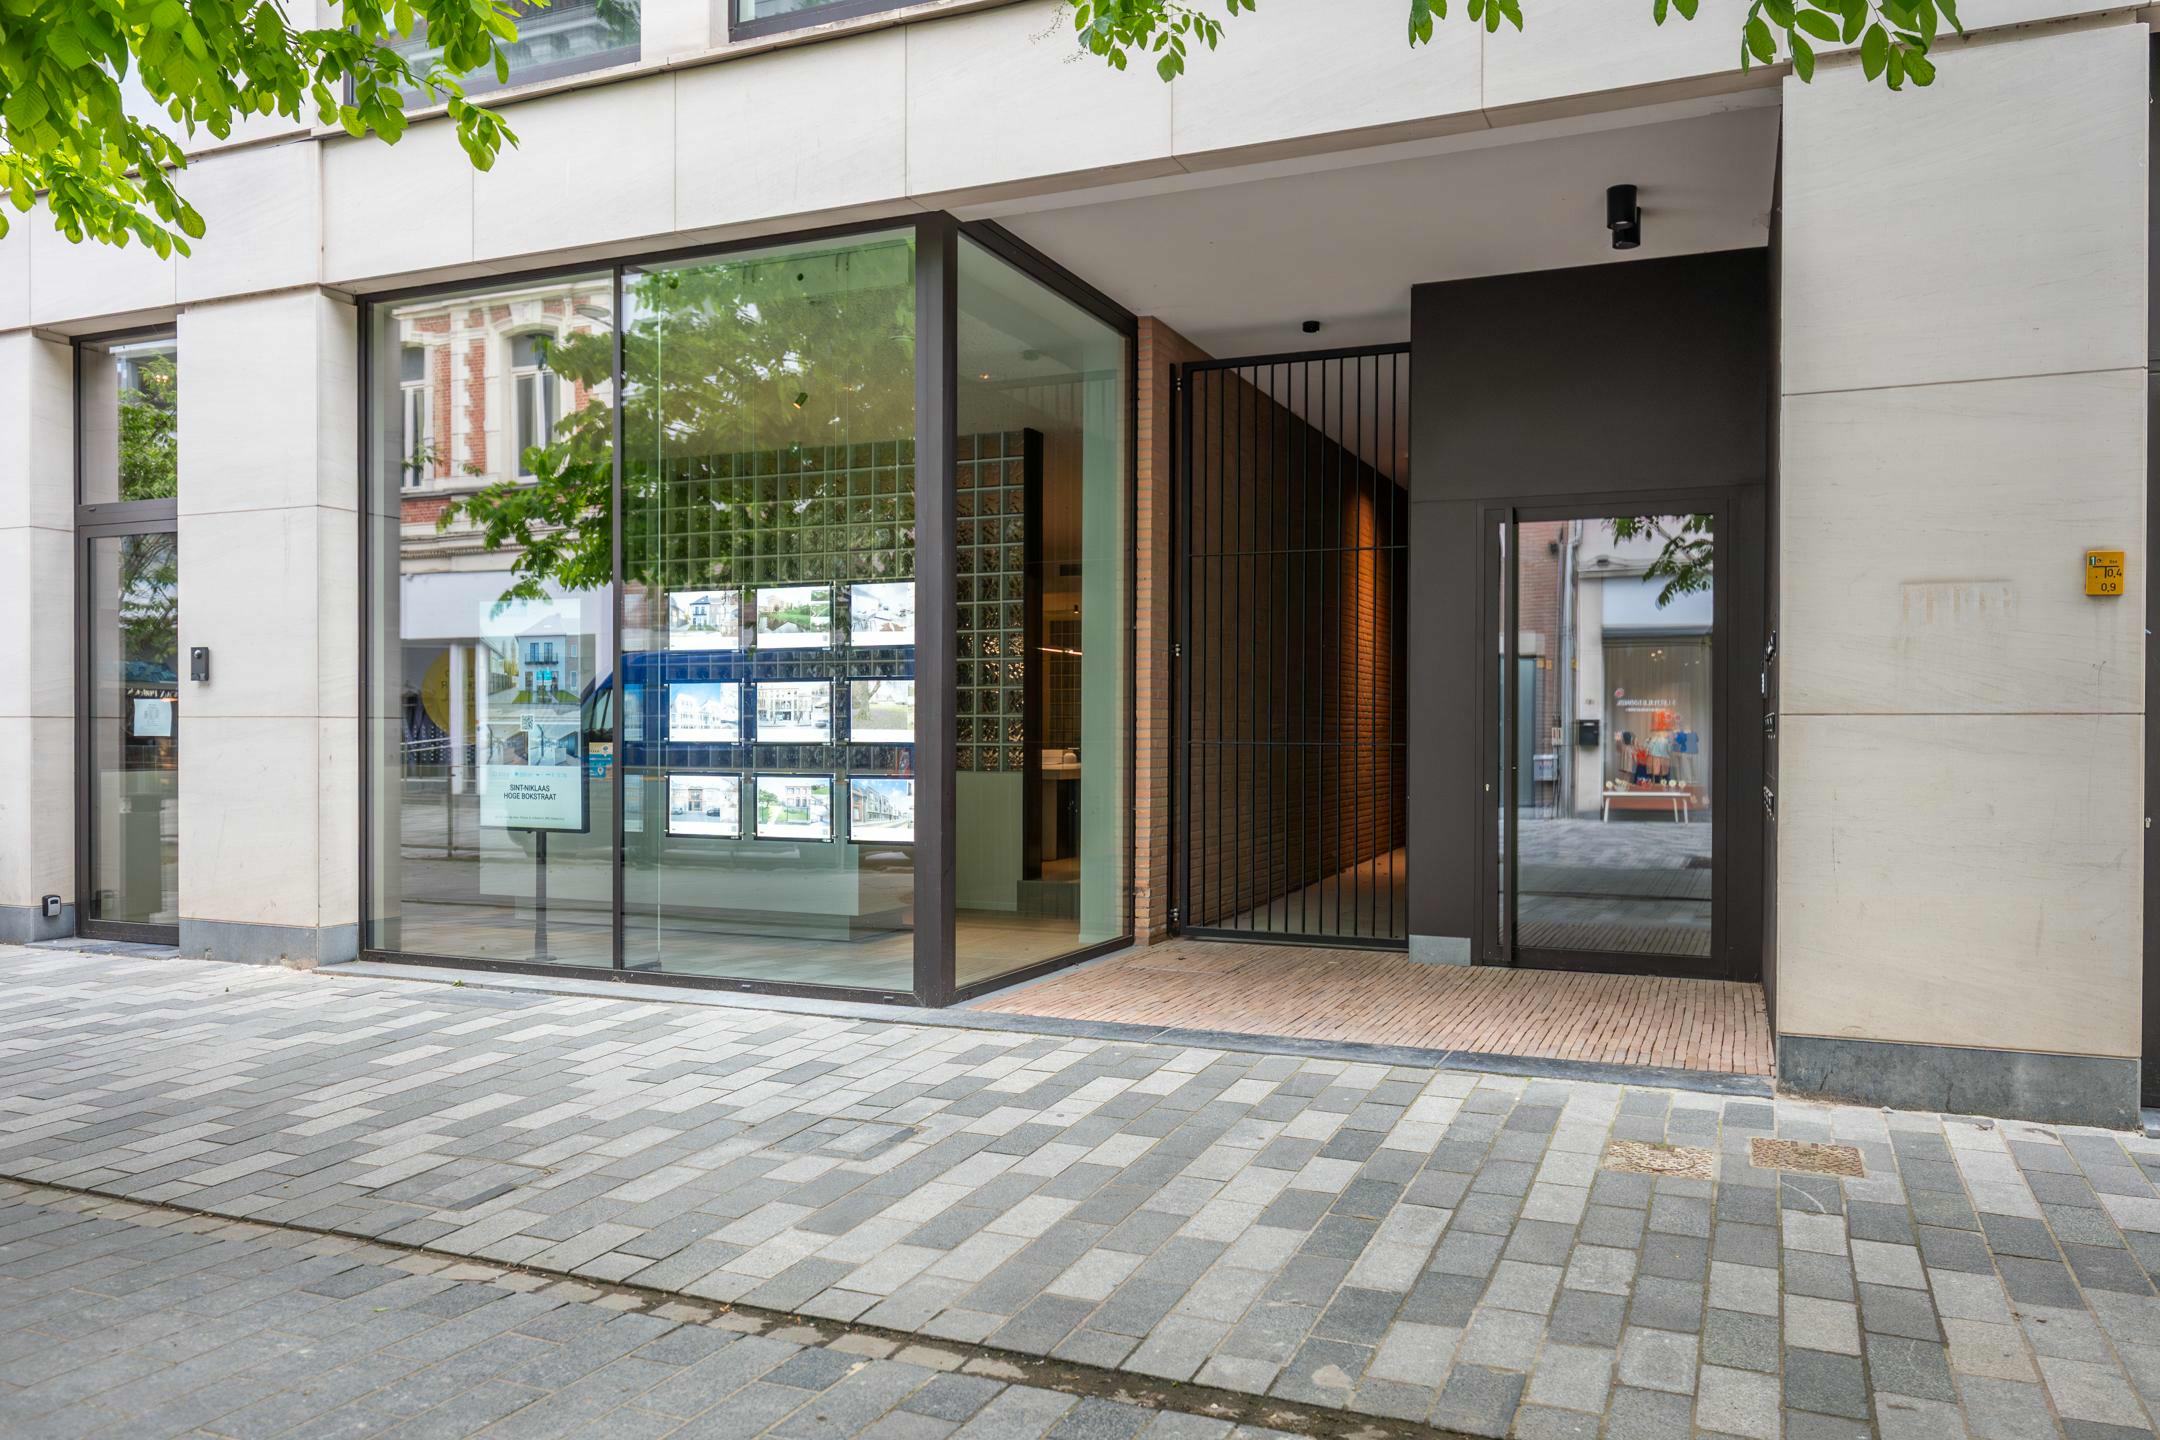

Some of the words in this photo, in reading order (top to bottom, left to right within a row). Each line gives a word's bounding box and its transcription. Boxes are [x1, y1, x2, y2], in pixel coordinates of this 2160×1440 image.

[509, 784, 550, 792] SINT-NIKLAAS
[503, 792, 520, 800] HOGE
[521, 793, 556, 801] BOKSTRAAT
